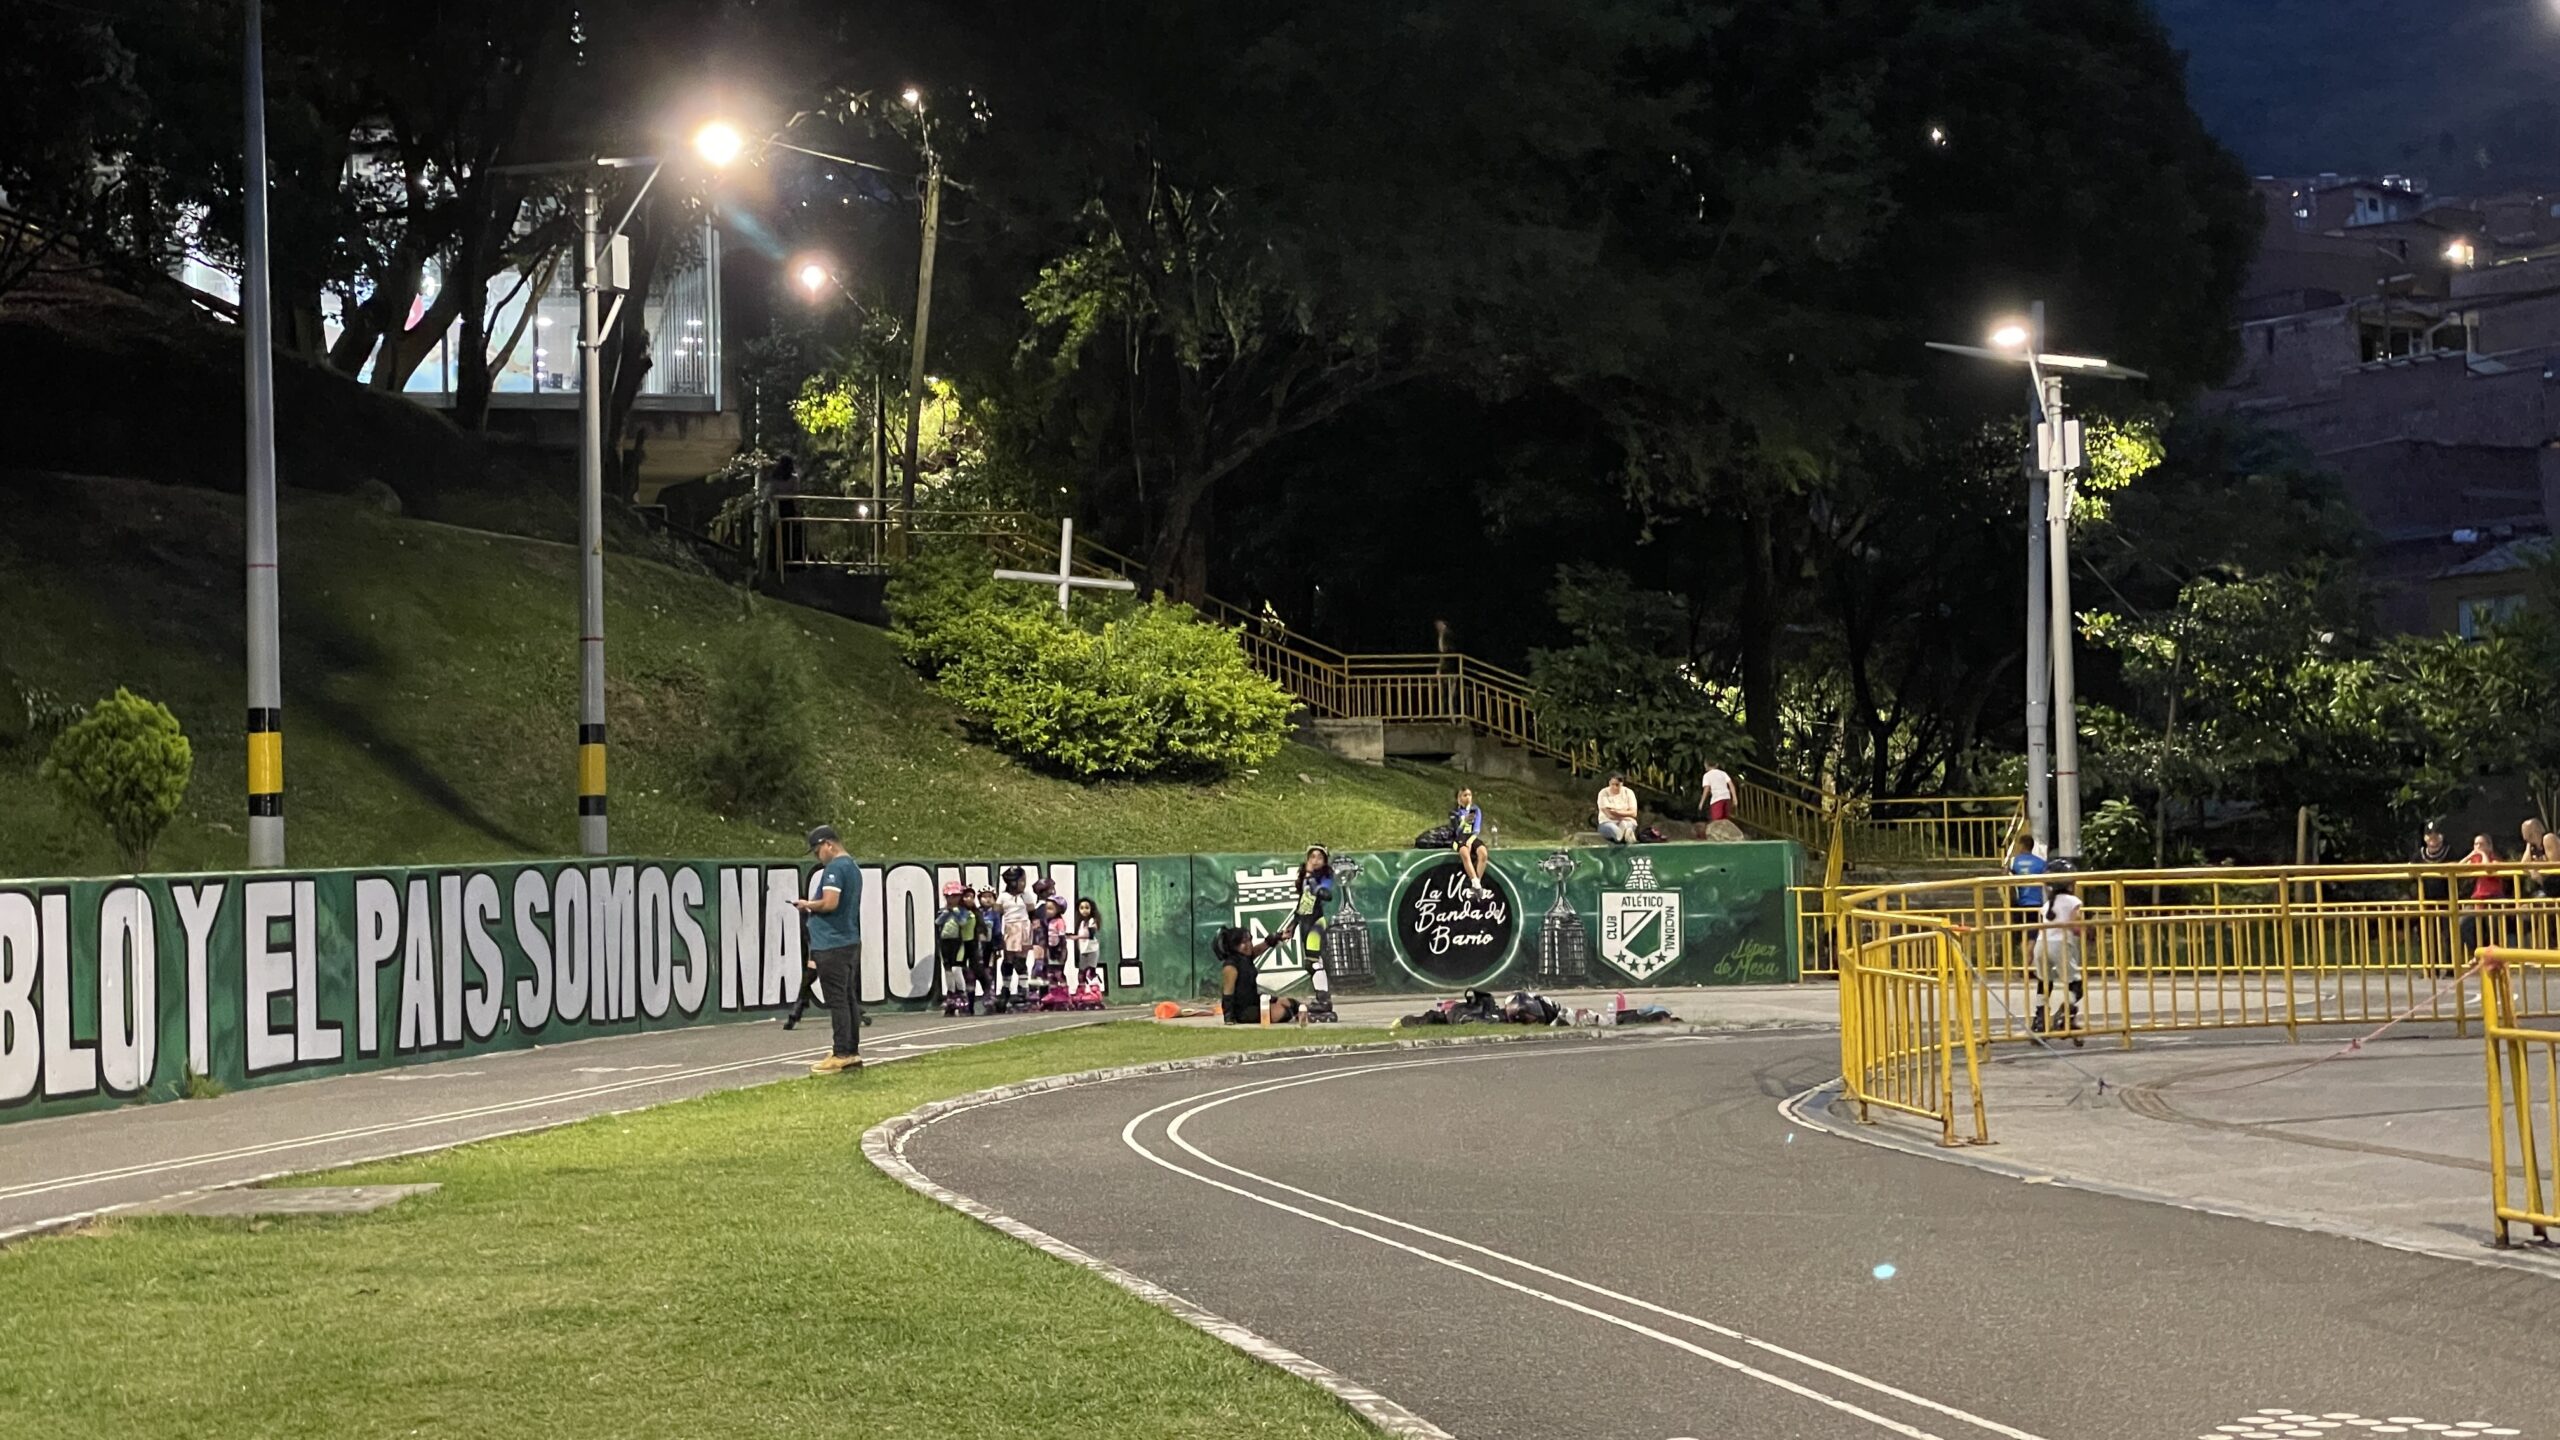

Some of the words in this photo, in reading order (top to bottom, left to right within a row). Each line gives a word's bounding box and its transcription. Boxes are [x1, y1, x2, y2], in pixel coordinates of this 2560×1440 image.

[1415, 878, 1442, 908] La
[1621, 894, 1663, 907] ATLÉTICO
[1415, 900, 1483, 933] Banda
[1485, 901, 1506, 924] del
[1606, 915, 1617, 940] CLUB
[1665, 906, 1675, 951] NACIONAL
[1429, 925, 1494, 954] Barrio
[171, 883, 226, 1075] Y
[245, 880, 343, 1070] EL
